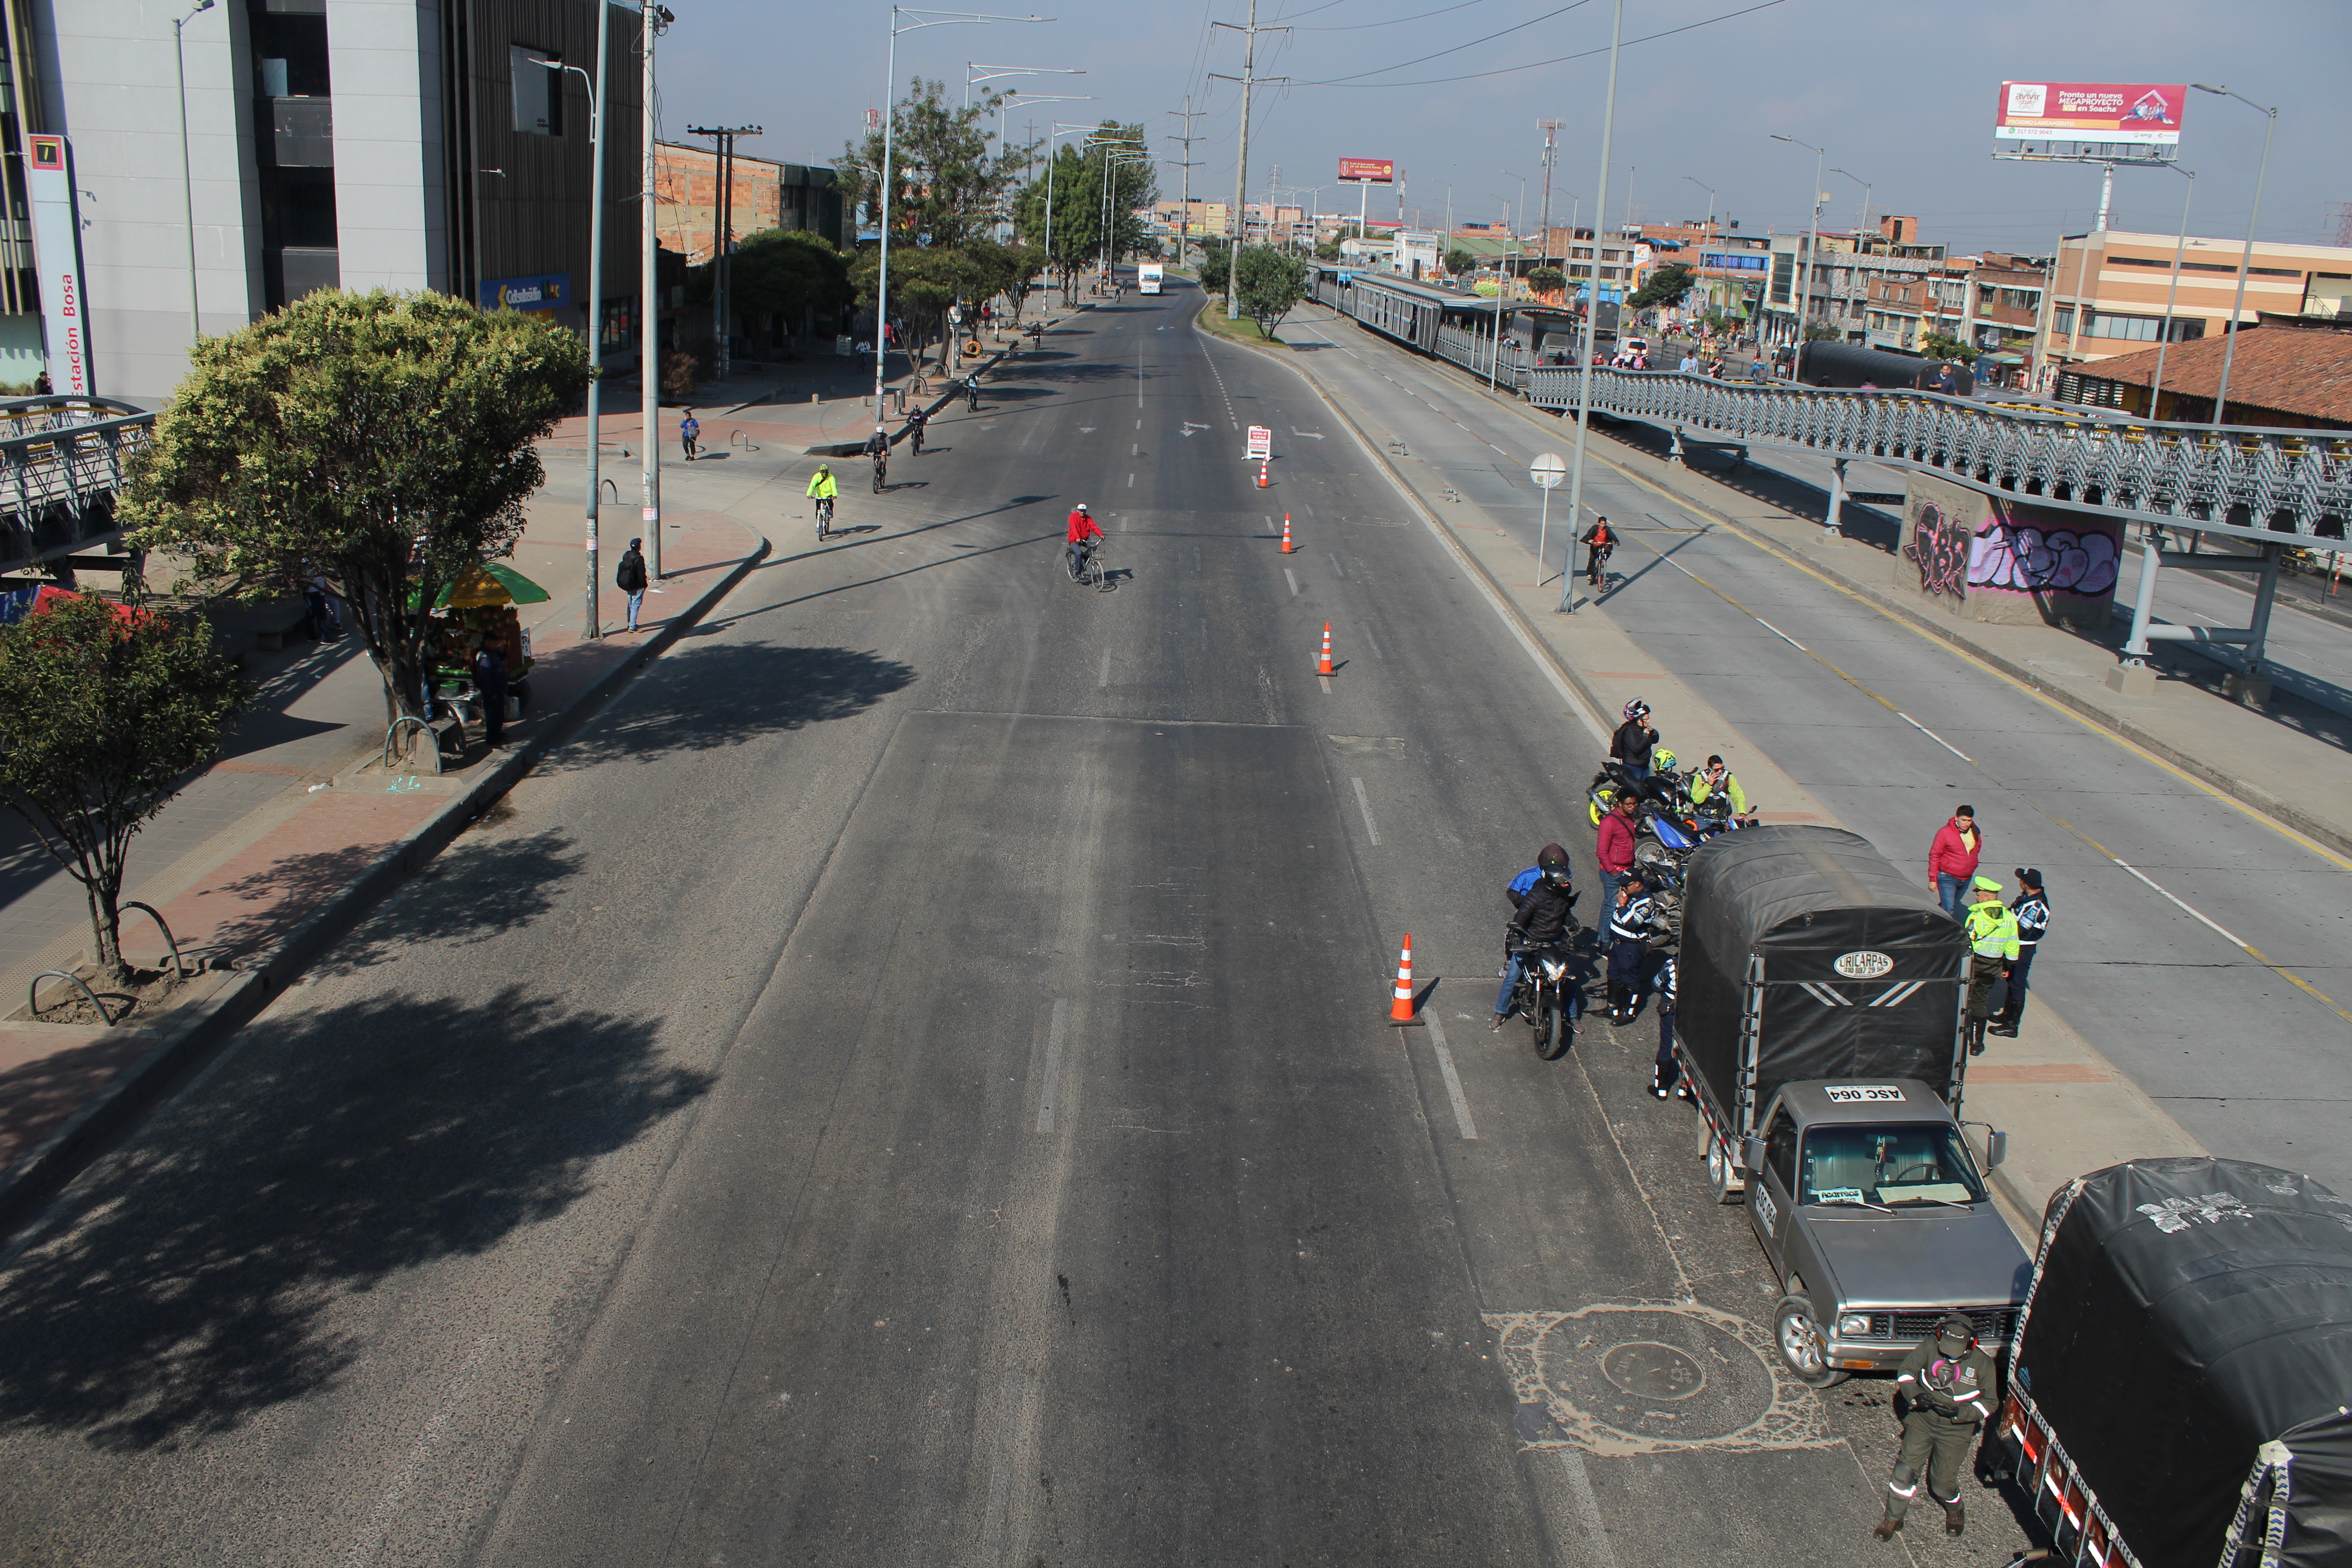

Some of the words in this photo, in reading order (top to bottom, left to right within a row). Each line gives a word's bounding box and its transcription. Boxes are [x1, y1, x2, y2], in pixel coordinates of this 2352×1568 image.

[2058, 98, 2124, 106] MEGAPROYECTO
[63, 274, 76, 317] Bosa
[505, 287, 542, 304] Colsubsidio
[1982, 920, 2012, 929] PCIA
[1839, 953, 1888, 967] URICARPAS
[1830, 1090, 1862, 1100] 064
[1865, 1090, 1899, 1099] ASC
[1756, 1187, 1767, 1213] ASC
[1766, 1203, 1776, 1228] 064
